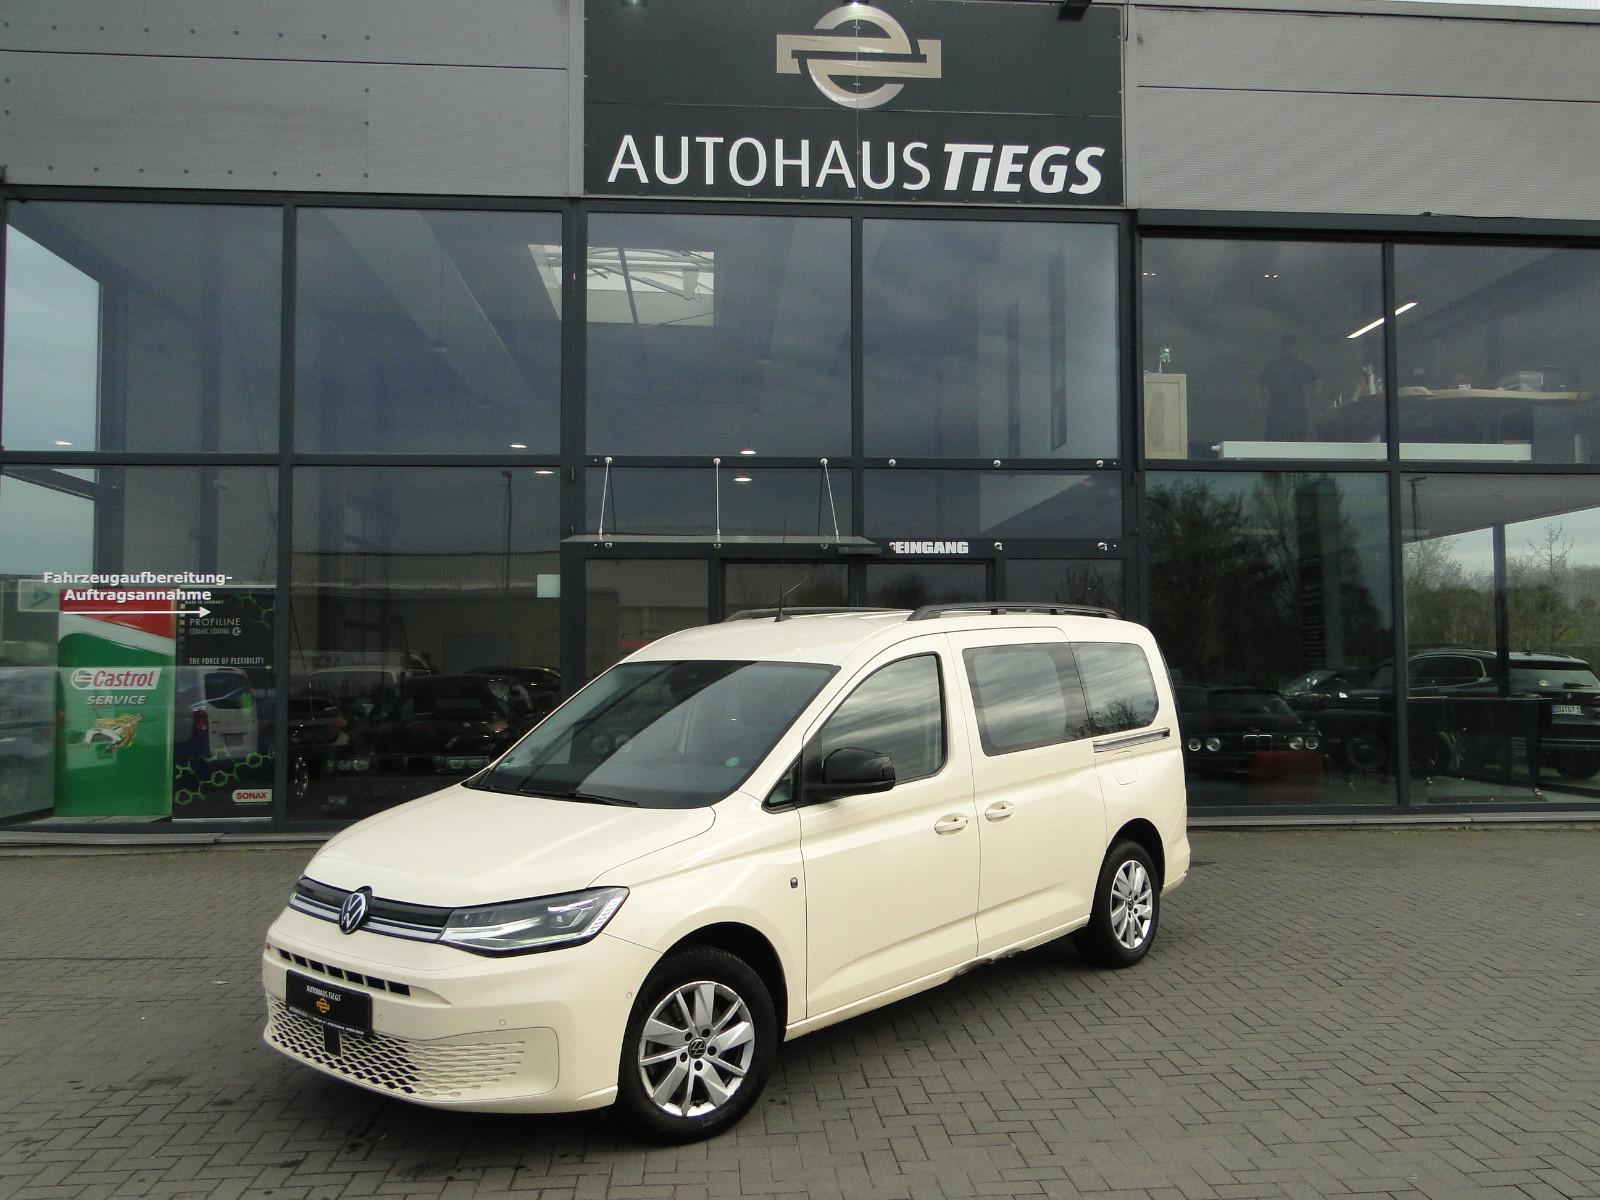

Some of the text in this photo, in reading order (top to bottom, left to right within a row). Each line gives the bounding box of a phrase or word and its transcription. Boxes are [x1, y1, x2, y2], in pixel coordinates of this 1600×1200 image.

[607, 134, 931, 190] AUTOHAUS
[896, 541, 969, 553] EINGANG
[43, 571, 233, 587] Fahrzeugaufbereitung-
[64, 589, 212, 602] Auftragsannahme
[189, 657, 264, 665] THE FORCE OF FLEXIBILITY
[93, 670, 154, 687] Castrol
[86, 695, 147, 705] SERVICE
[236, 791, 268, 800] SONAX
